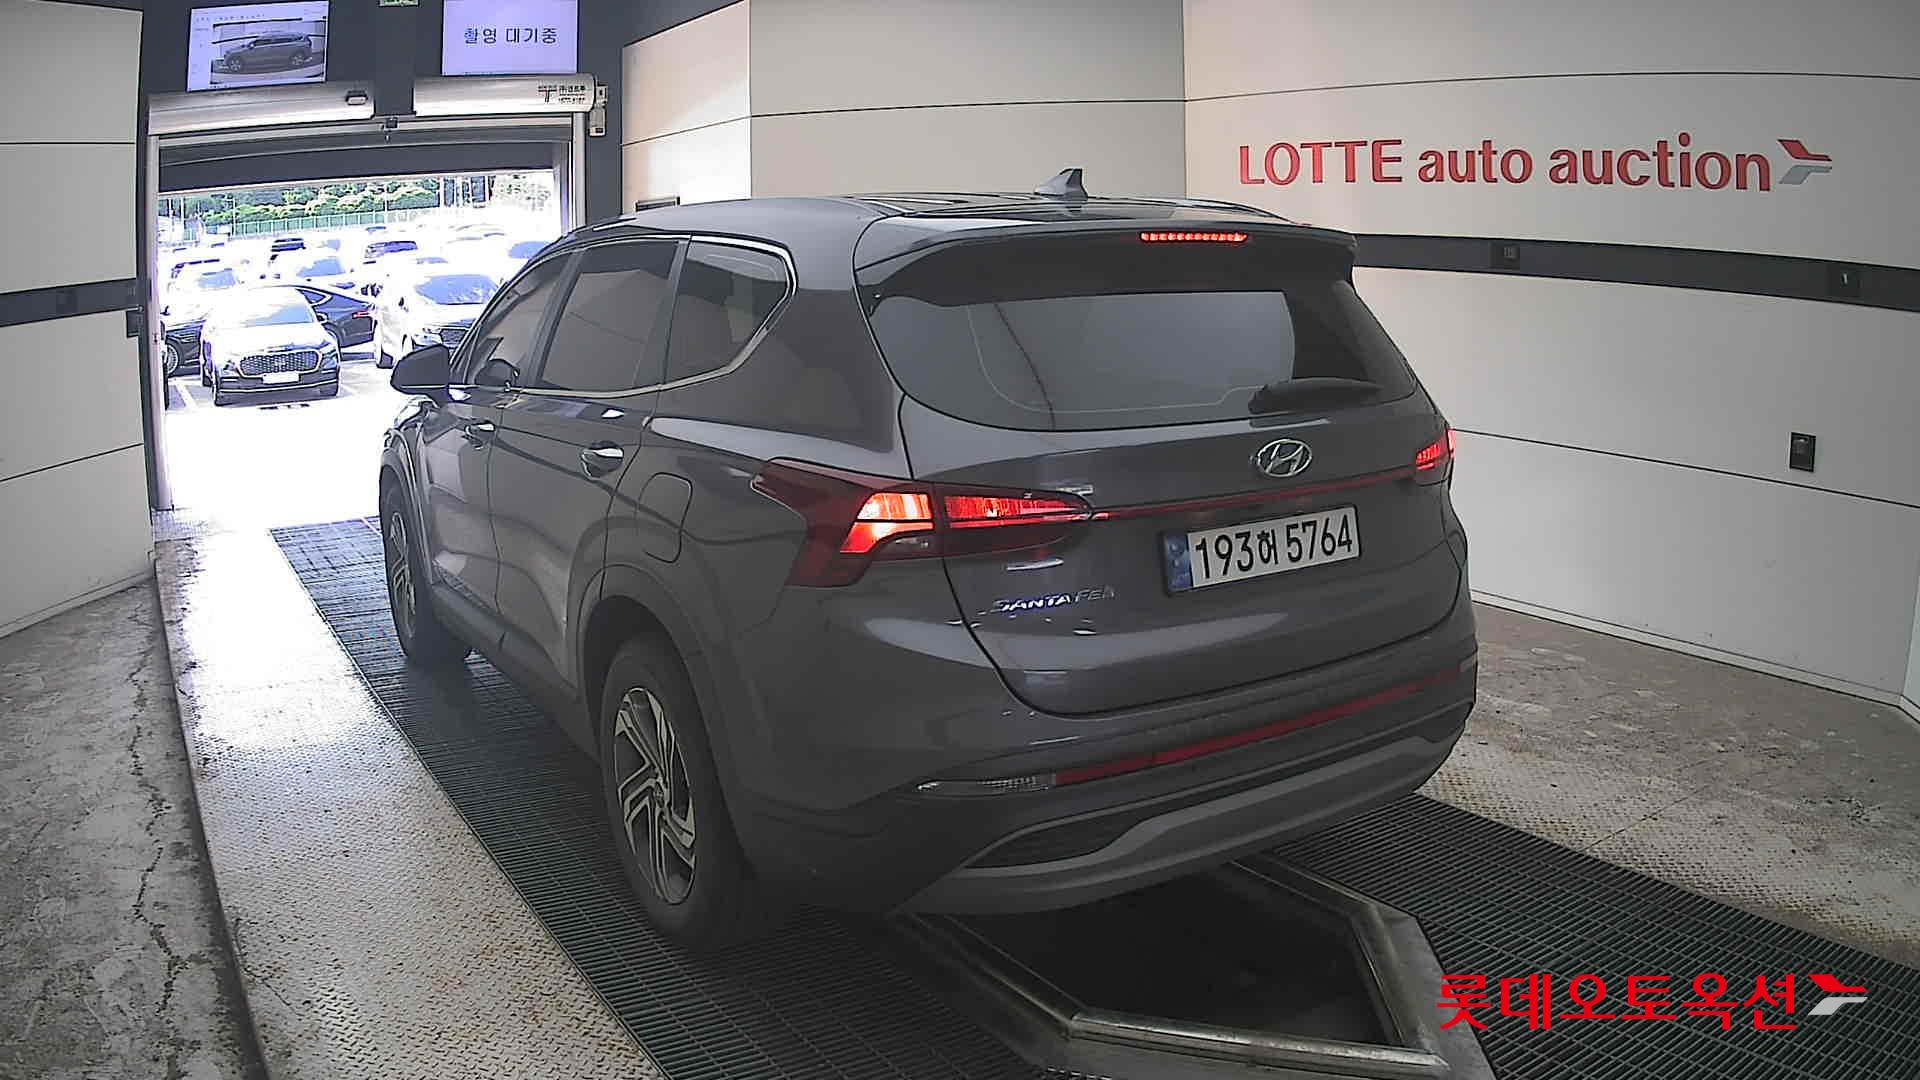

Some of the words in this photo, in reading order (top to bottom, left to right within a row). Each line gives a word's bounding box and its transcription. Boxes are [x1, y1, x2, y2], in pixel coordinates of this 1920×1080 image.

[505, 28, 557, 44] 대기중
[1239, 138, 1402, 186] LOTTE
[1418, 139, 1533, 185] auto
[1549, 132, 1771, 191] auction
[1195, 526, 1279, 579] 193허
[1286, 514, 1353, 563] 5764
[990, 593, 1072, 613] SANTA
